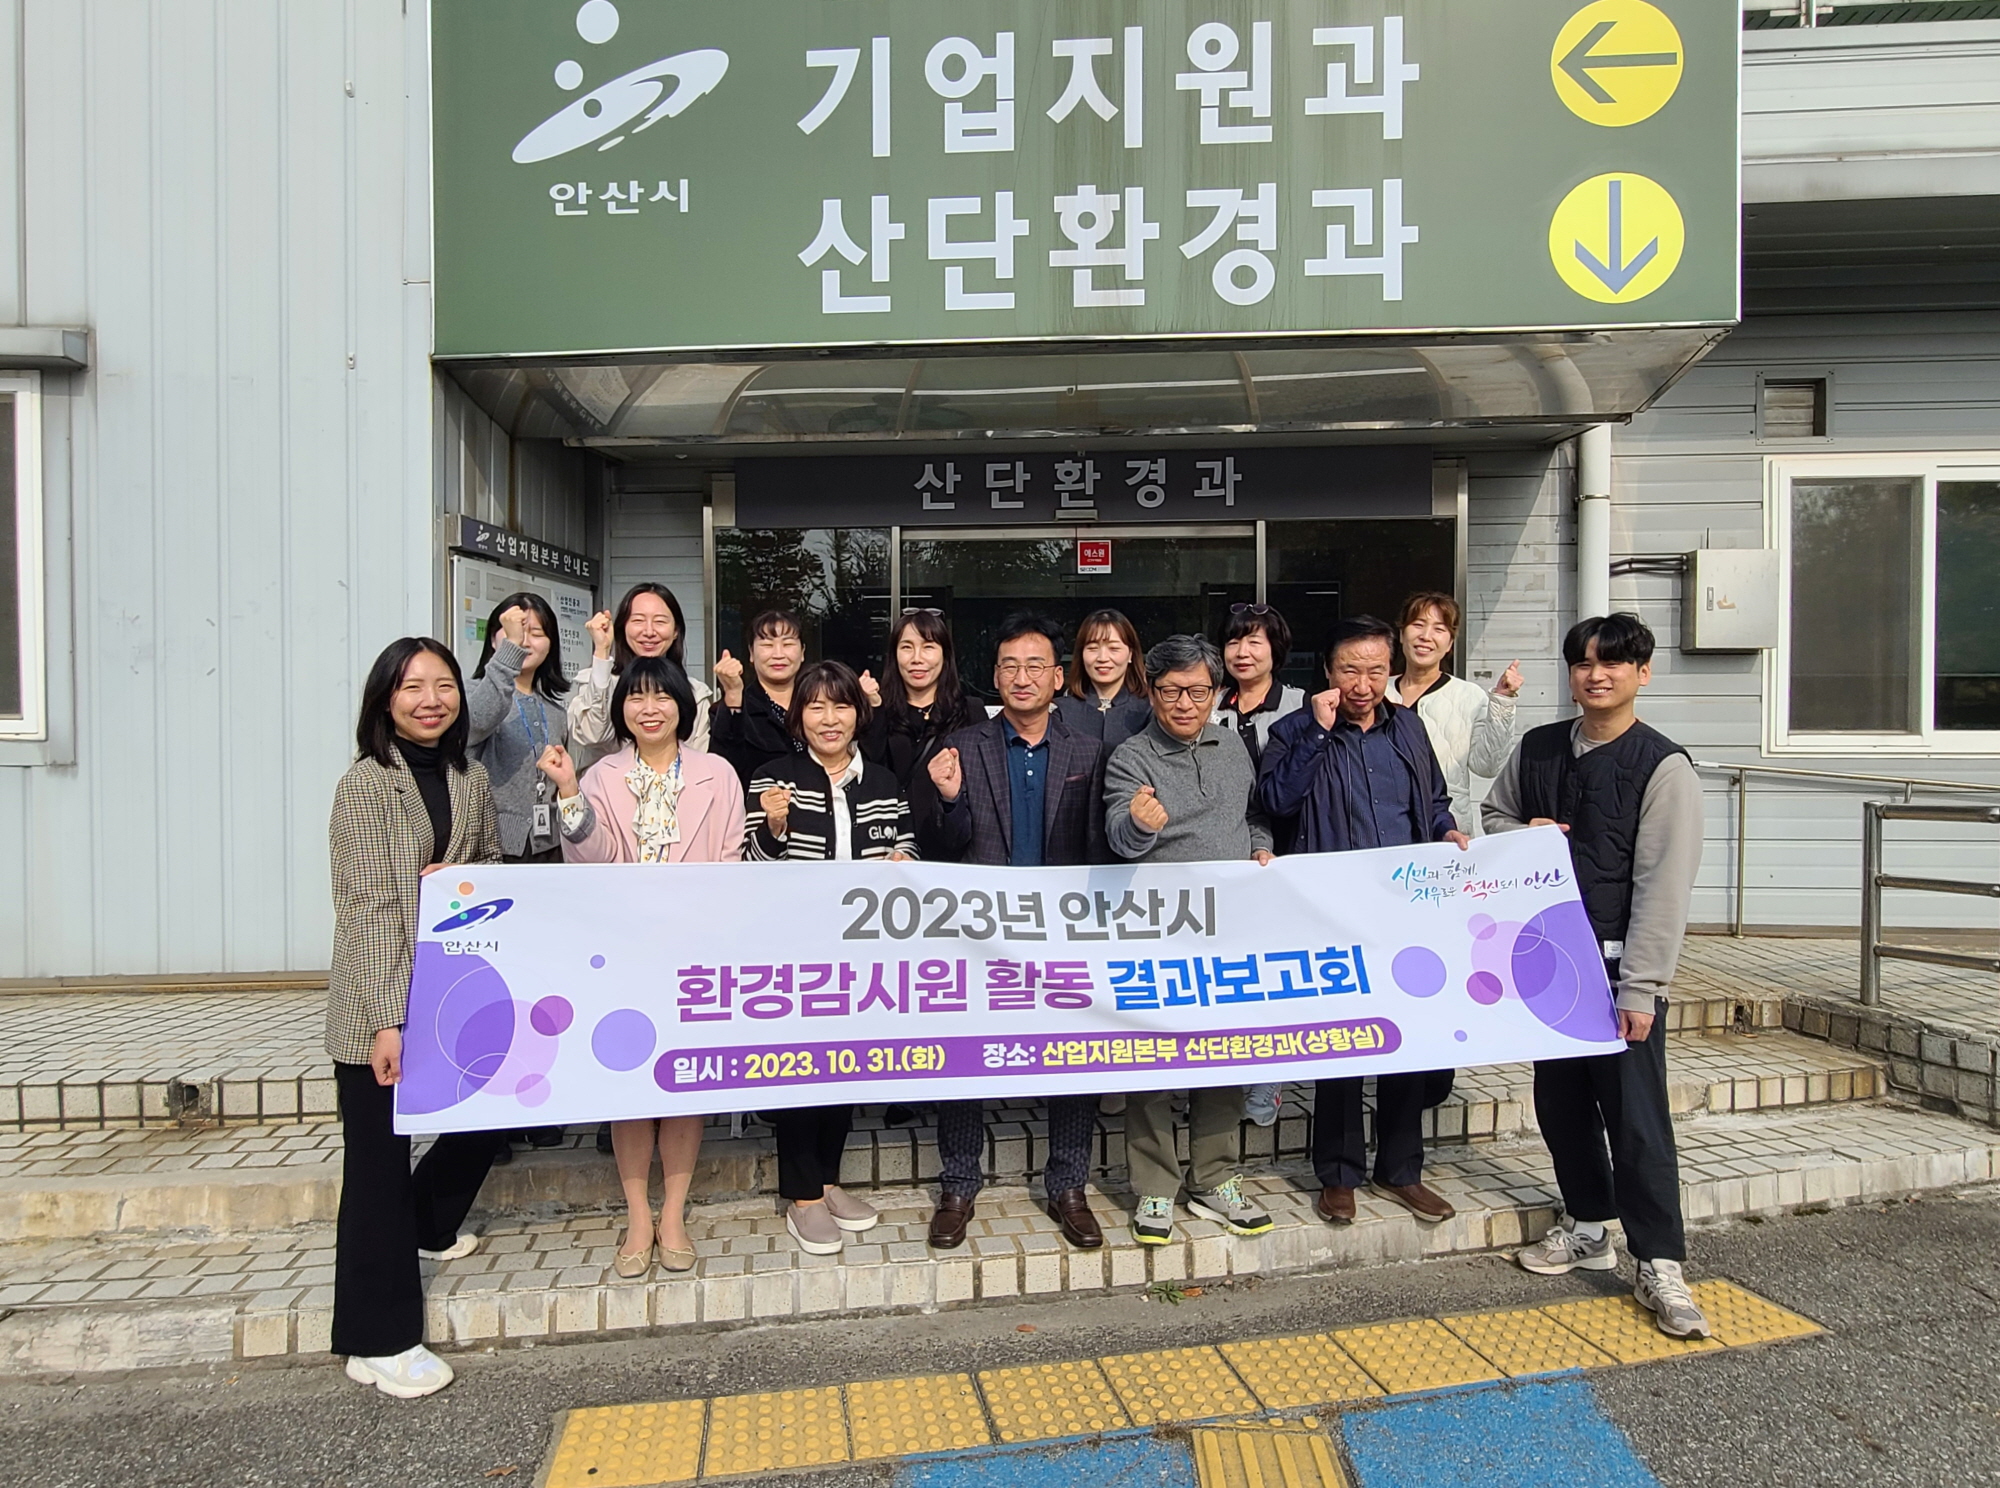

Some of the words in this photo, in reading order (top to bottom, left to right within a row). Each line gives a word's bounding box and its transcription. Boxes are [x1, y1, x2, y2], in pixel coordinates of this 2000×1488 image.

[797, 14, 1420, 158] 기업지원과
[549, 179, 690, 216] 안산시
[797, 178, 1420, 314] 산단환경과
[913, 456, 1243, 511] 산단환경과
[495, 532, 560, 569] 산업지원본부
[563, 554, 590, 577] 안내도
[1391, 861, 1442, 890] 시민과
[1410, 887, 1457, 908] 자유로운
[1463, 879, 1518, 901] 혁신도시
[1524, 868, 1570, 890] 안산
[841, 886, 1048, 941] 2023년
[1058, 886, 1217, 941] 안산시
[444, 939, 500, 954] 안산시
[676, 958, 968, 1023] 환경감시원
[984, 958, 1095, 1012] 활동
[1106, 944, 1372, 1011] 결과보고회
[744, 1051, 820, 1080] 2023.
[826, 1048, 863, 1074] 10.
[866, 1044, 946, 1074] 31.(화)
[982, 1042, 1036, 1069] 장소:
[1041, 1036, 1179, 1066] 산업지원본부
[1184, 1024, 1386, 1061] 산단환경과(상황실)
